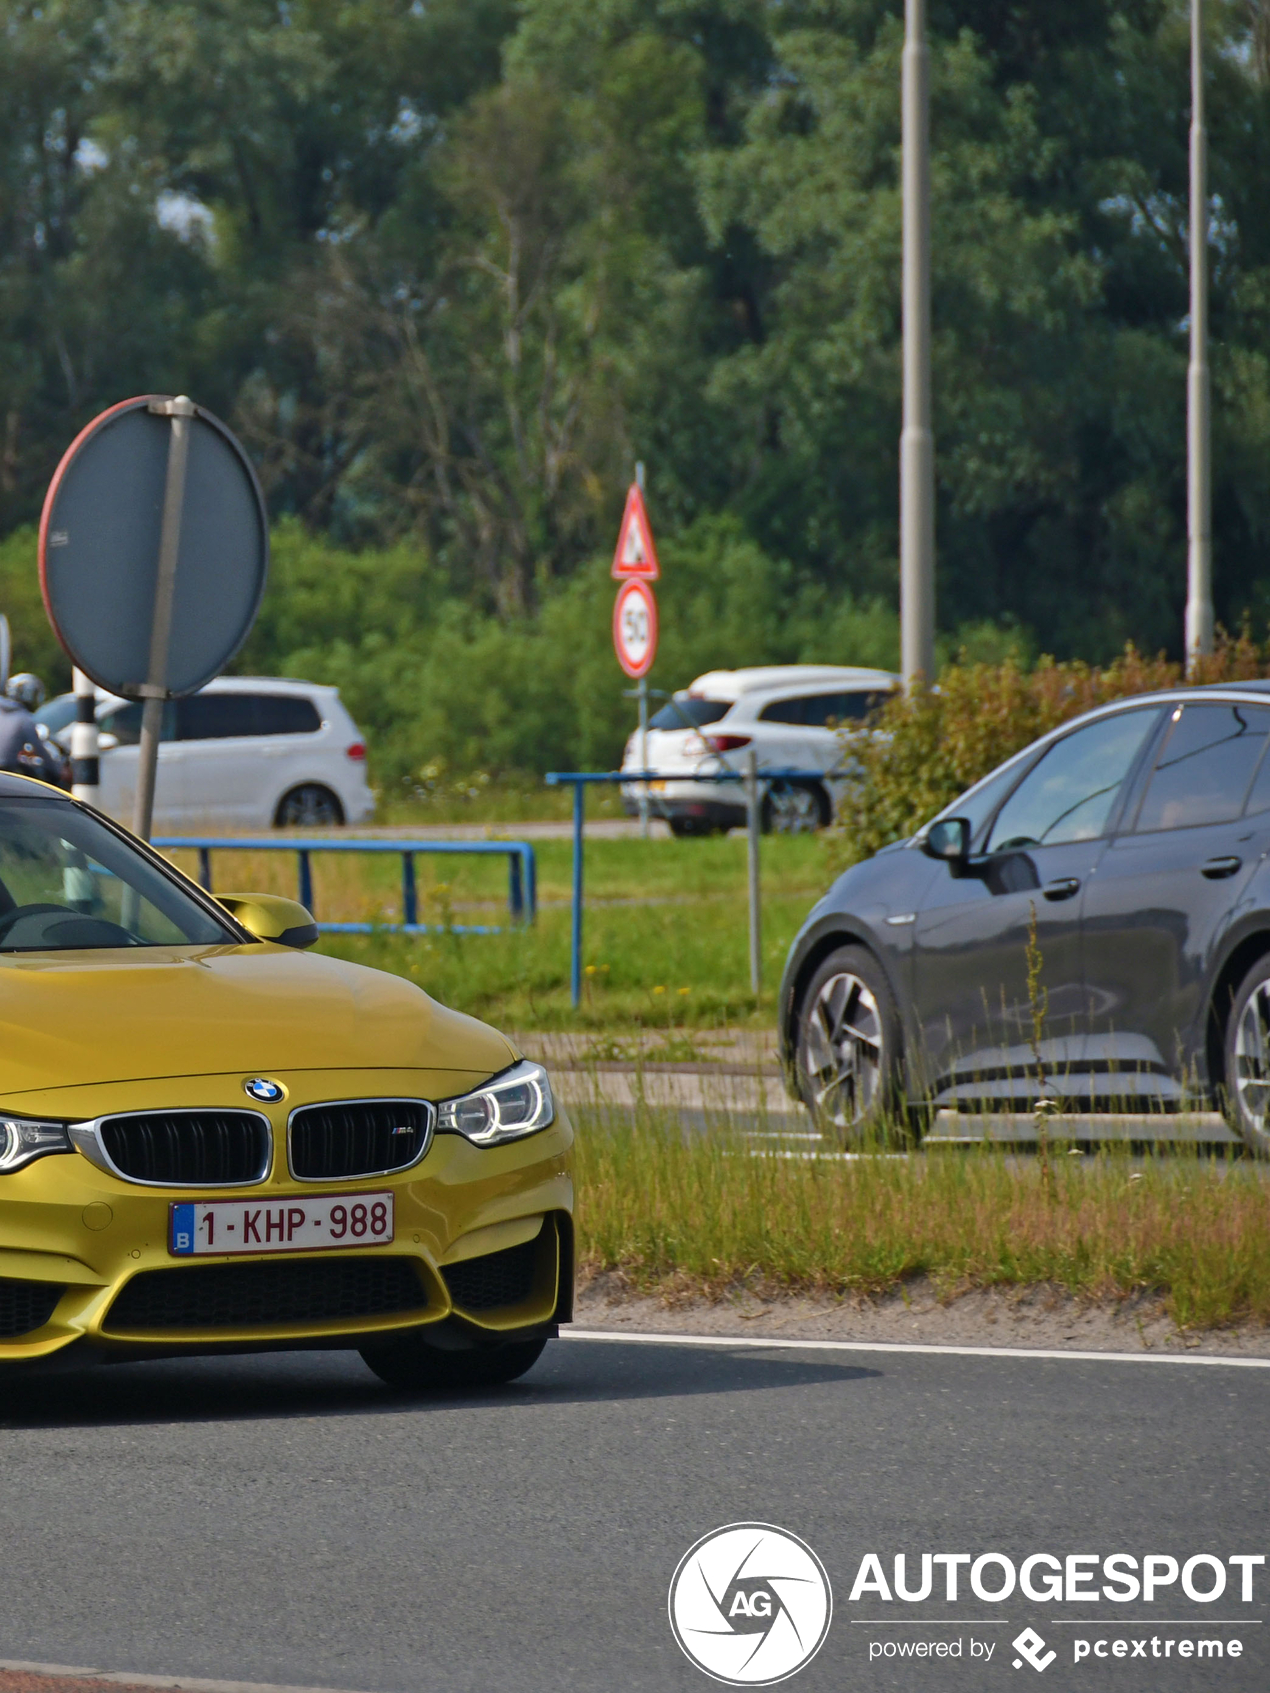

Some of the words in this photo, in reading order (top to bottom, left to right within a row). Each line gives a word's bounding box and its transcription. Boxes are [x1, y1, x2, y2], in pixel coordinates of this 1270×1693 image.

[625, 611, 648, 642] 50
[202, 1202, 387, 1245] 1-KHP-988
[177, 1233, 189, 1248] B
